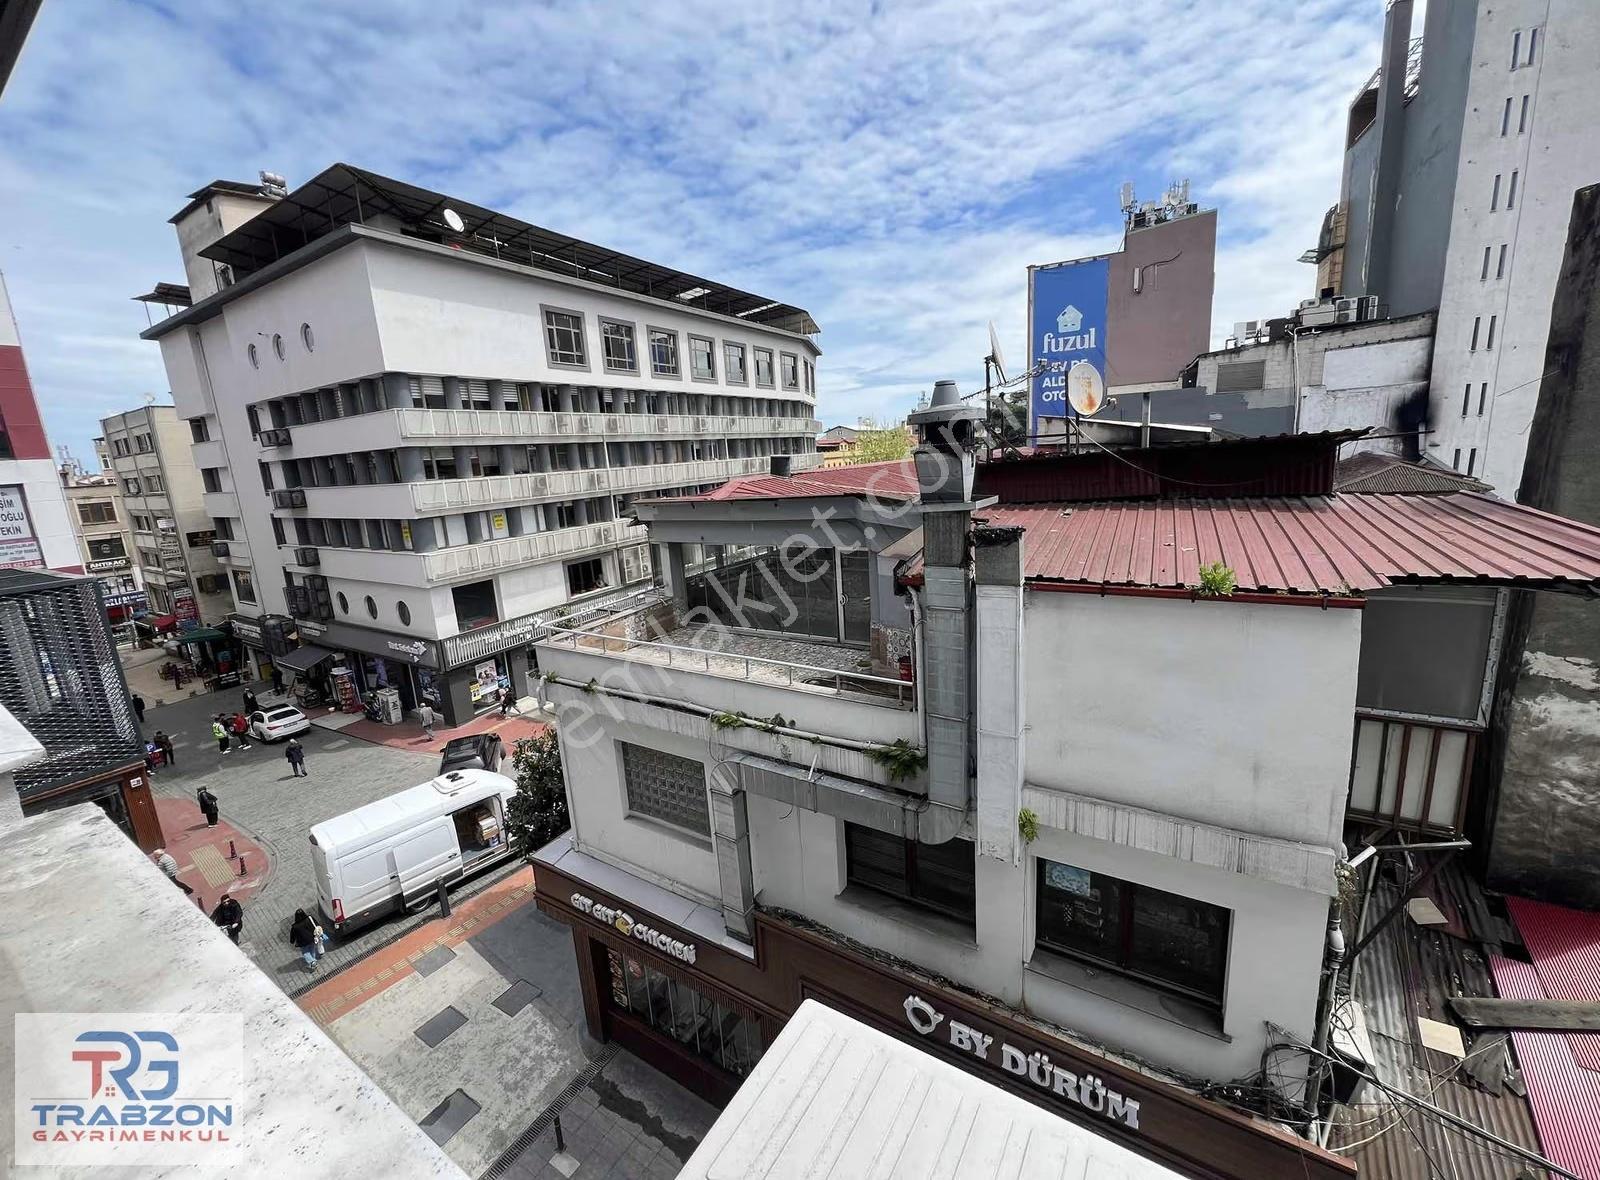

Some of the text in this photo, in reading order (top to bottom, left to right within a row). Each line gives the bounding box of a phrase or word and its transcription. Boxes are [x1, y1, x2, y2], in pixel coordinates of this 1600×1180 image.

[1042, 327, 1096, 354] fuzul
[1042, 376, 1065, 388] ALD
[1042, 391, 1066, 402] OTO
[0, 524, 22, 536] EKİN
[633, 922, 696, 965] CHICKEN
[949, 1019, 1140, 1130] BY DÜRÜM
